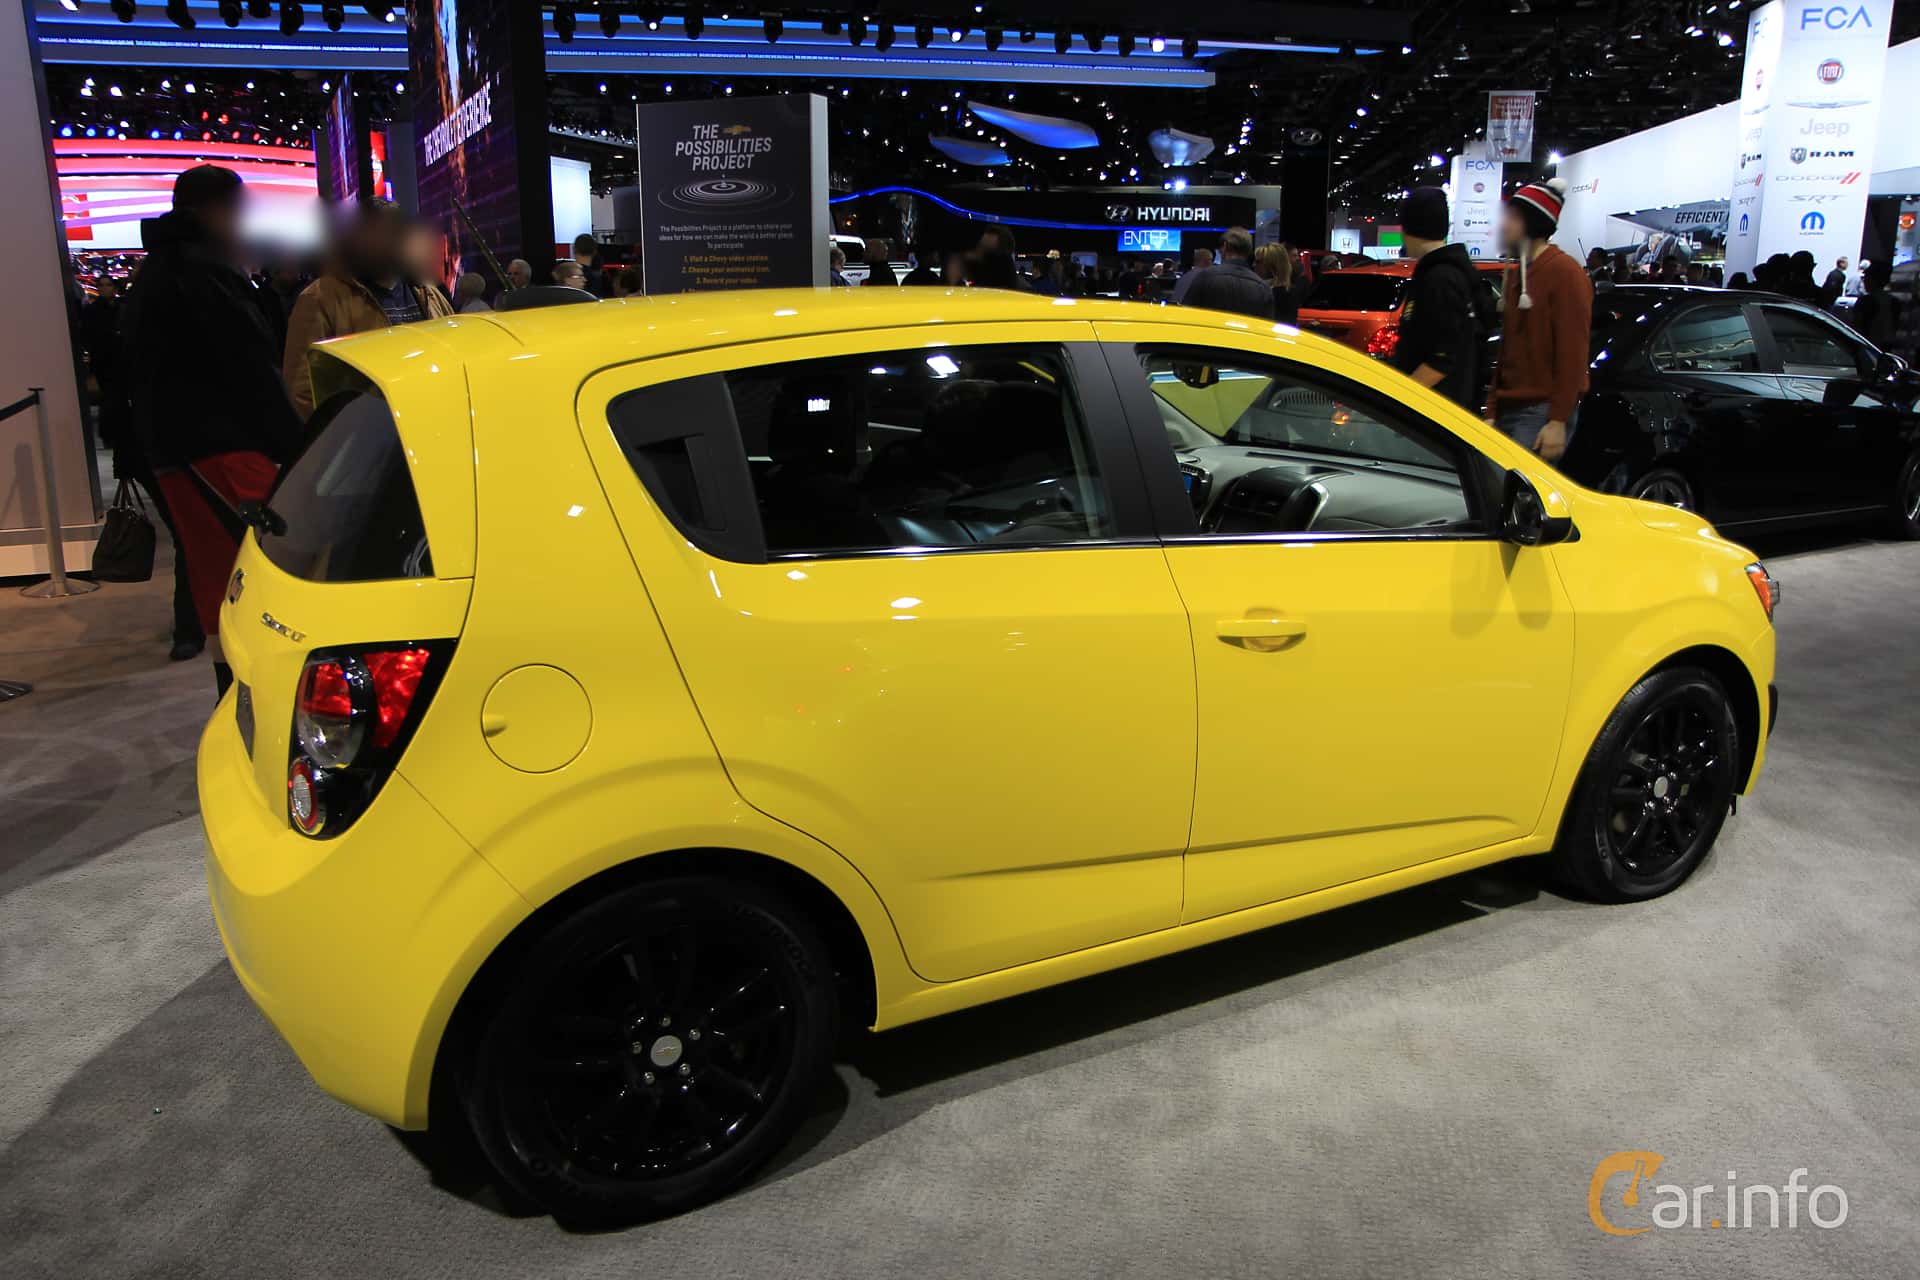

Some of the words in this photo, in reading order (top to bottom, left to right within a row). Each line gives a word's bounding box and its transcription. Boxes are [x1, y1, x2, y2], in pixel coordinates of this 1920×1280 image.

[1801, 5, 1873, 31] FCA
[693, 124, 720, 140] THE
[1800, 118, 1851, 138] Jeep
[675, 137, 773, 157] POSSIBILITIES
[692, 154, 756, 172] PROJECT
[1465, 160, 1496, 171] FCA
[1137, 206, 1210, 221] HYUNDAI
[1675, 211, 1725, 224] EFFICIENT
